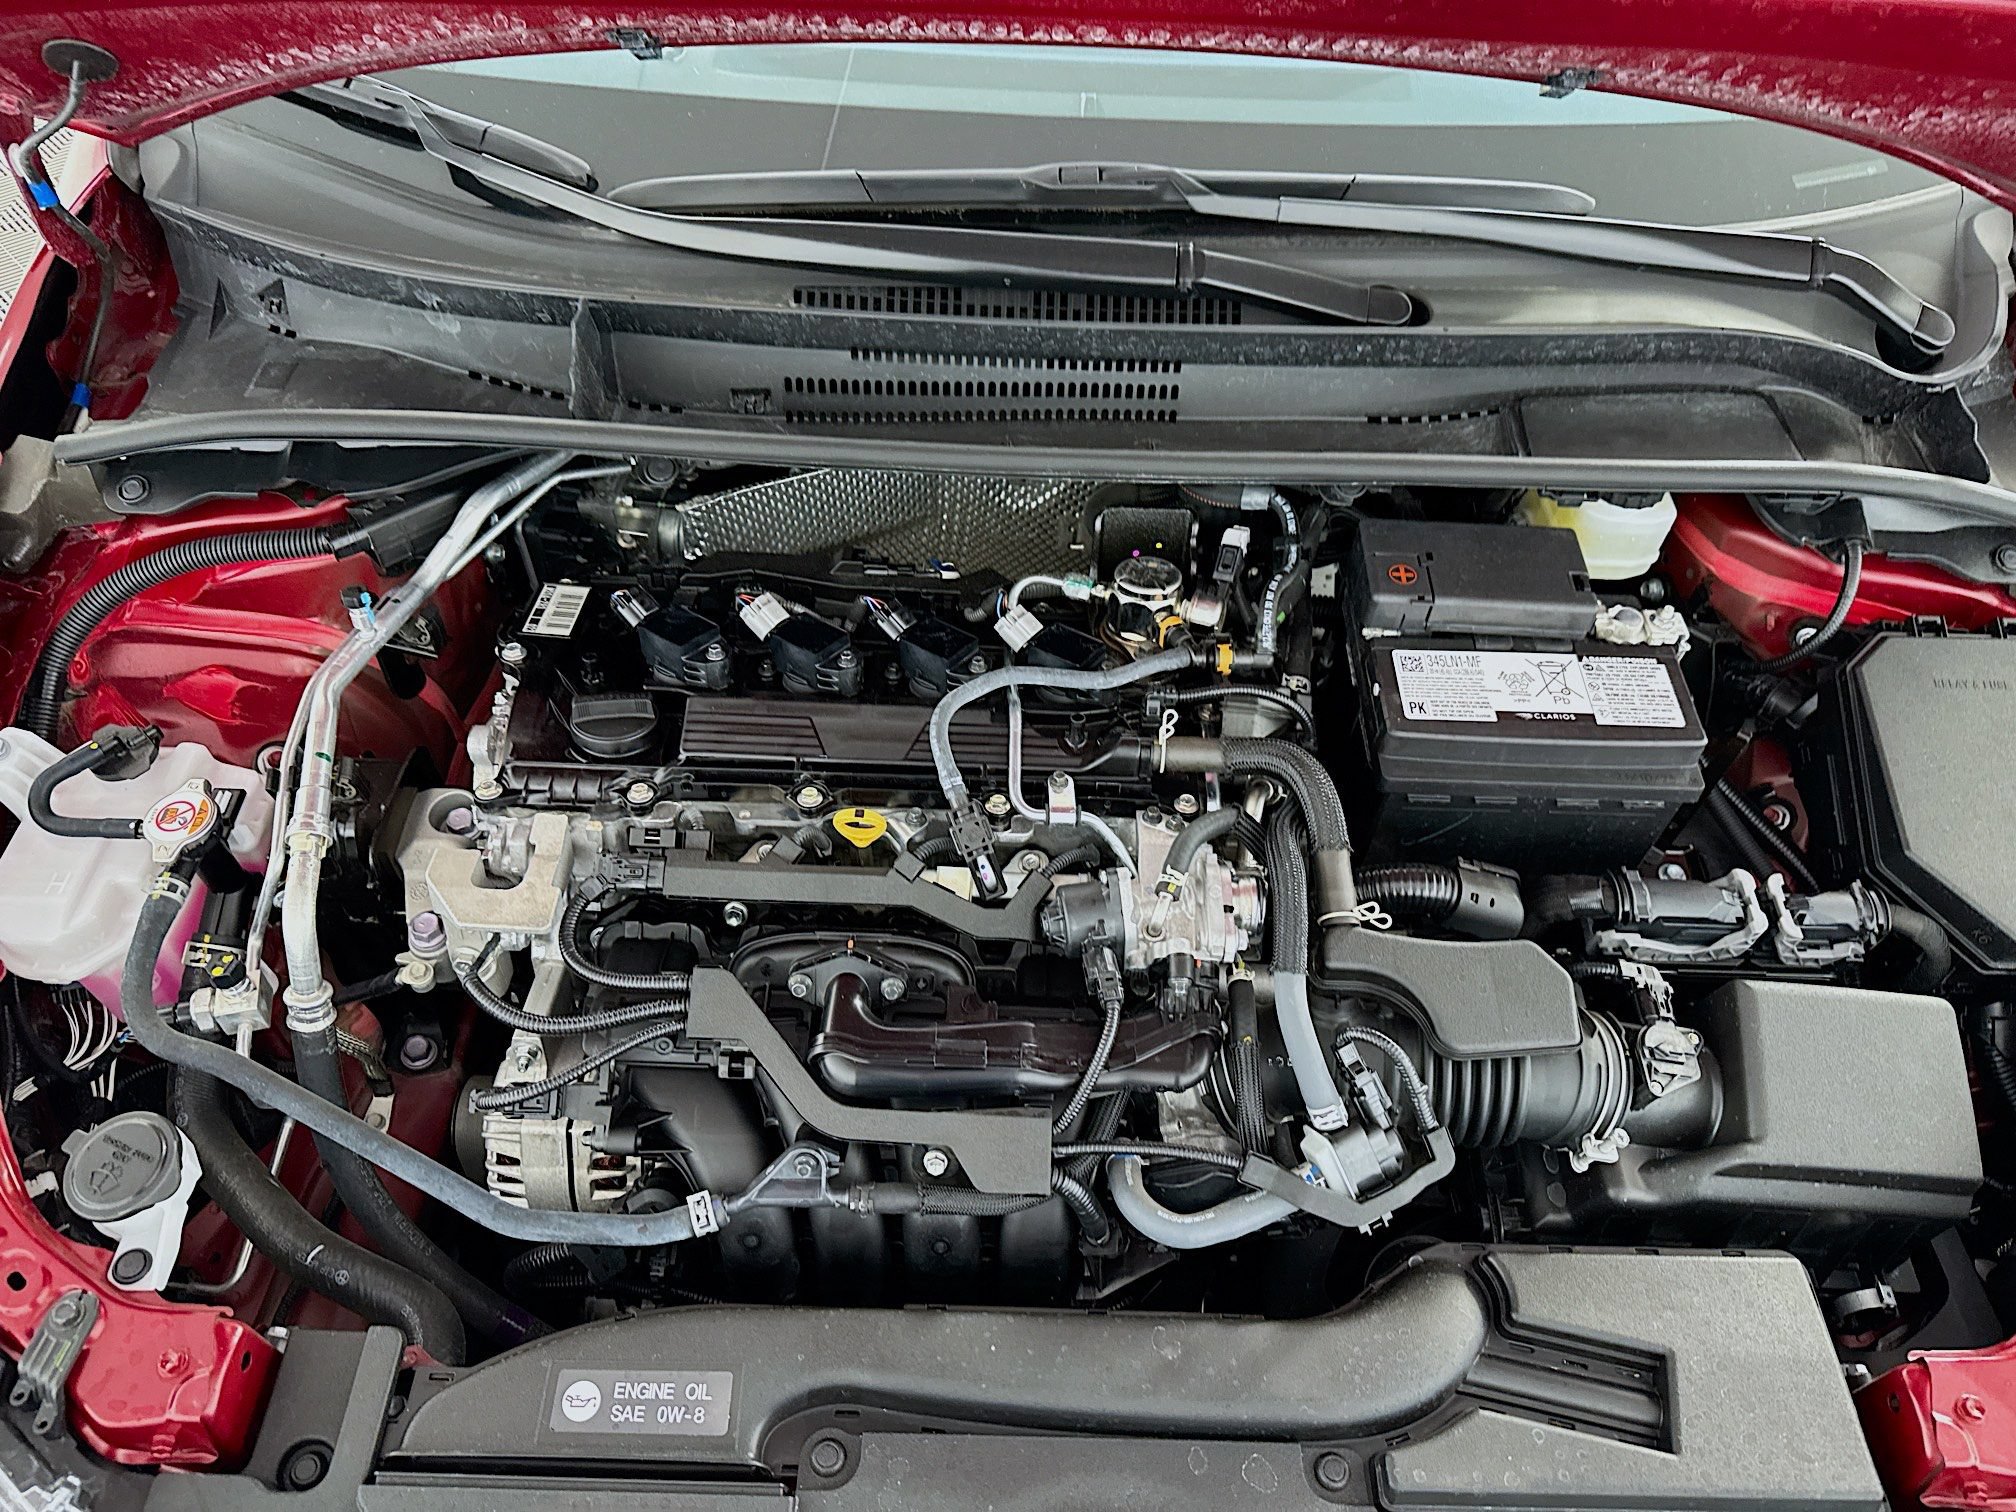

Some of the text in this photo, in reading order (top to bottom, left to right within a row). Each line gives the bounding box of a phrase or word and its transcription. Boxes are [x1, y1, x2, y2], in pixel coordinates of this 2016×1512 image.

[1426, 654, 1482, 668] 345LN1-MF
[1553, 696, 1571, 705] Pb
[1408, 701, 1427, 715] PK
[1533, 712, 1577, 721] CLARIOS
[613, 1381, 713, 1401] ENGINE OIL
[610, 1404, 706, 1424] SAE 0W-8
